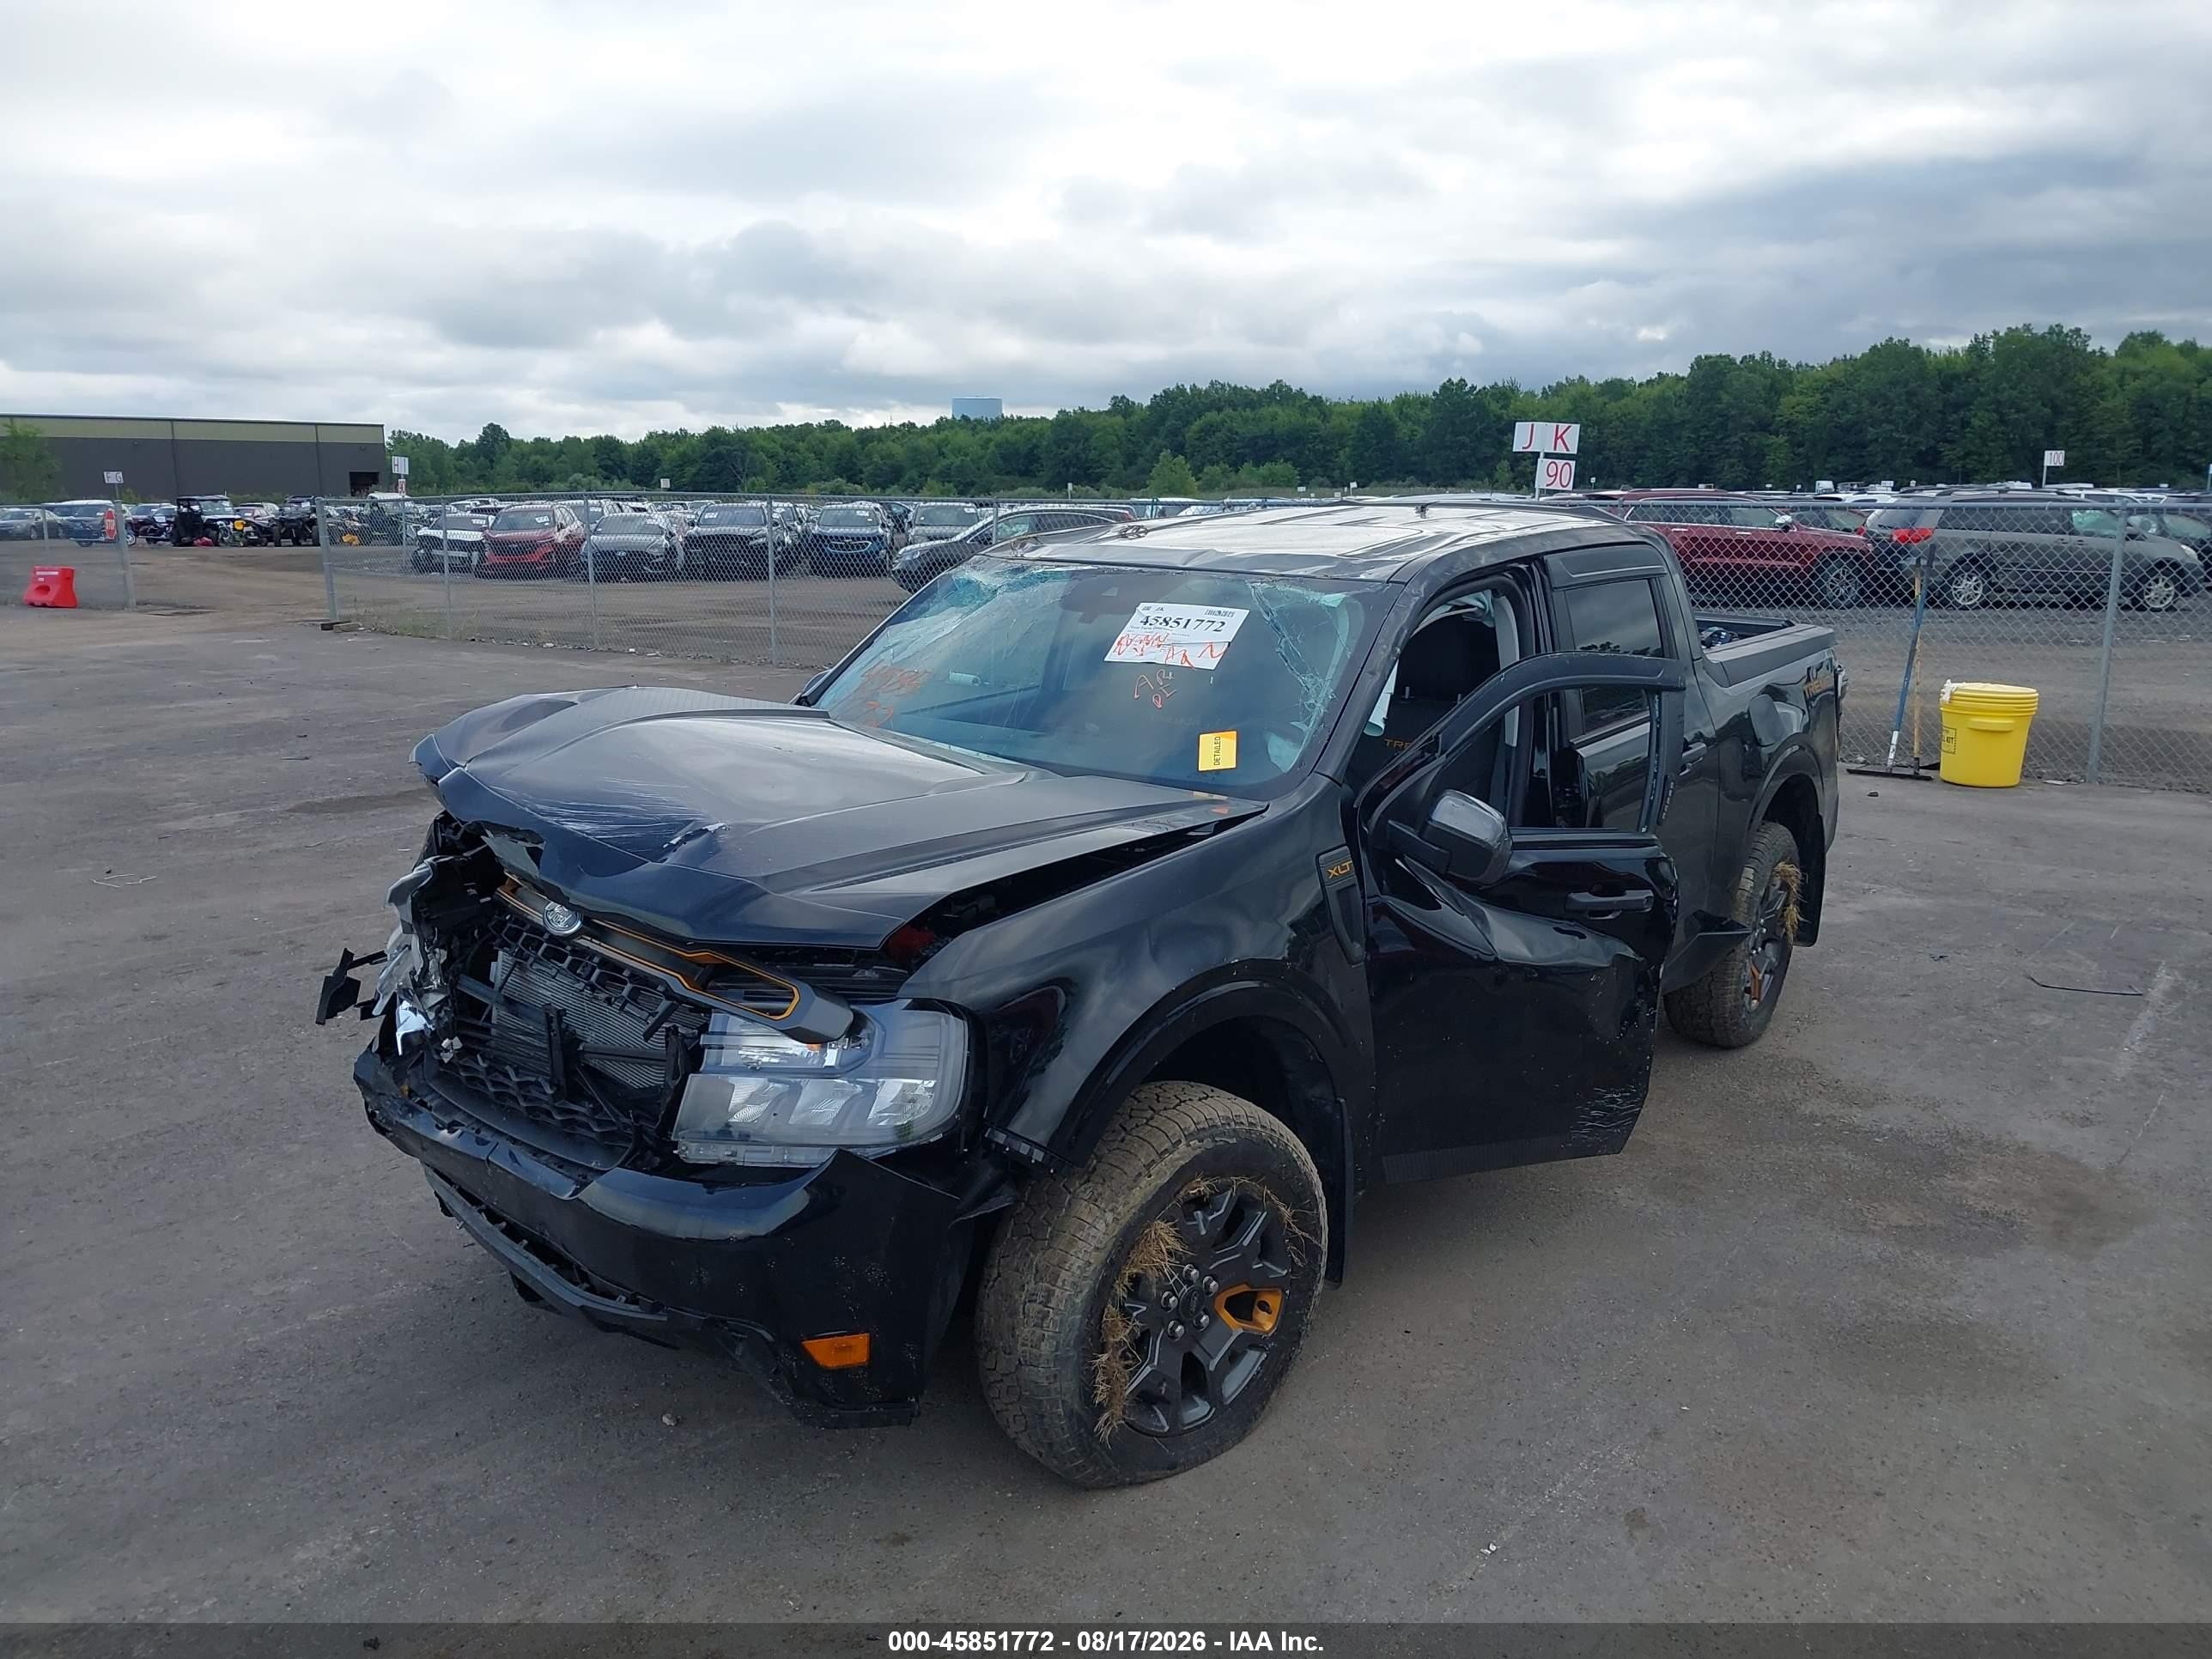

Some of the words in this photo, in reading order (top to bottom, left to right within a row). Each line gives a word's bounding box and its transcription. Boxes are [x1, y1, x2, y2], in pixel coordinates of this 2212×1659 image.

[1522, 423, 1534, 450] J
[1553, 424, 1572, 452] K
[393, 457, 399, 472] H
[2049, 452, 2063, 465] 100
[106, 472, 111, 482] F
[116, 472, 122, 482] G
[1546, 460, 1572, 488] 90
[1139, 615, 1226, 633] 45851772
[1327, 860, 1353, 879] XLT
